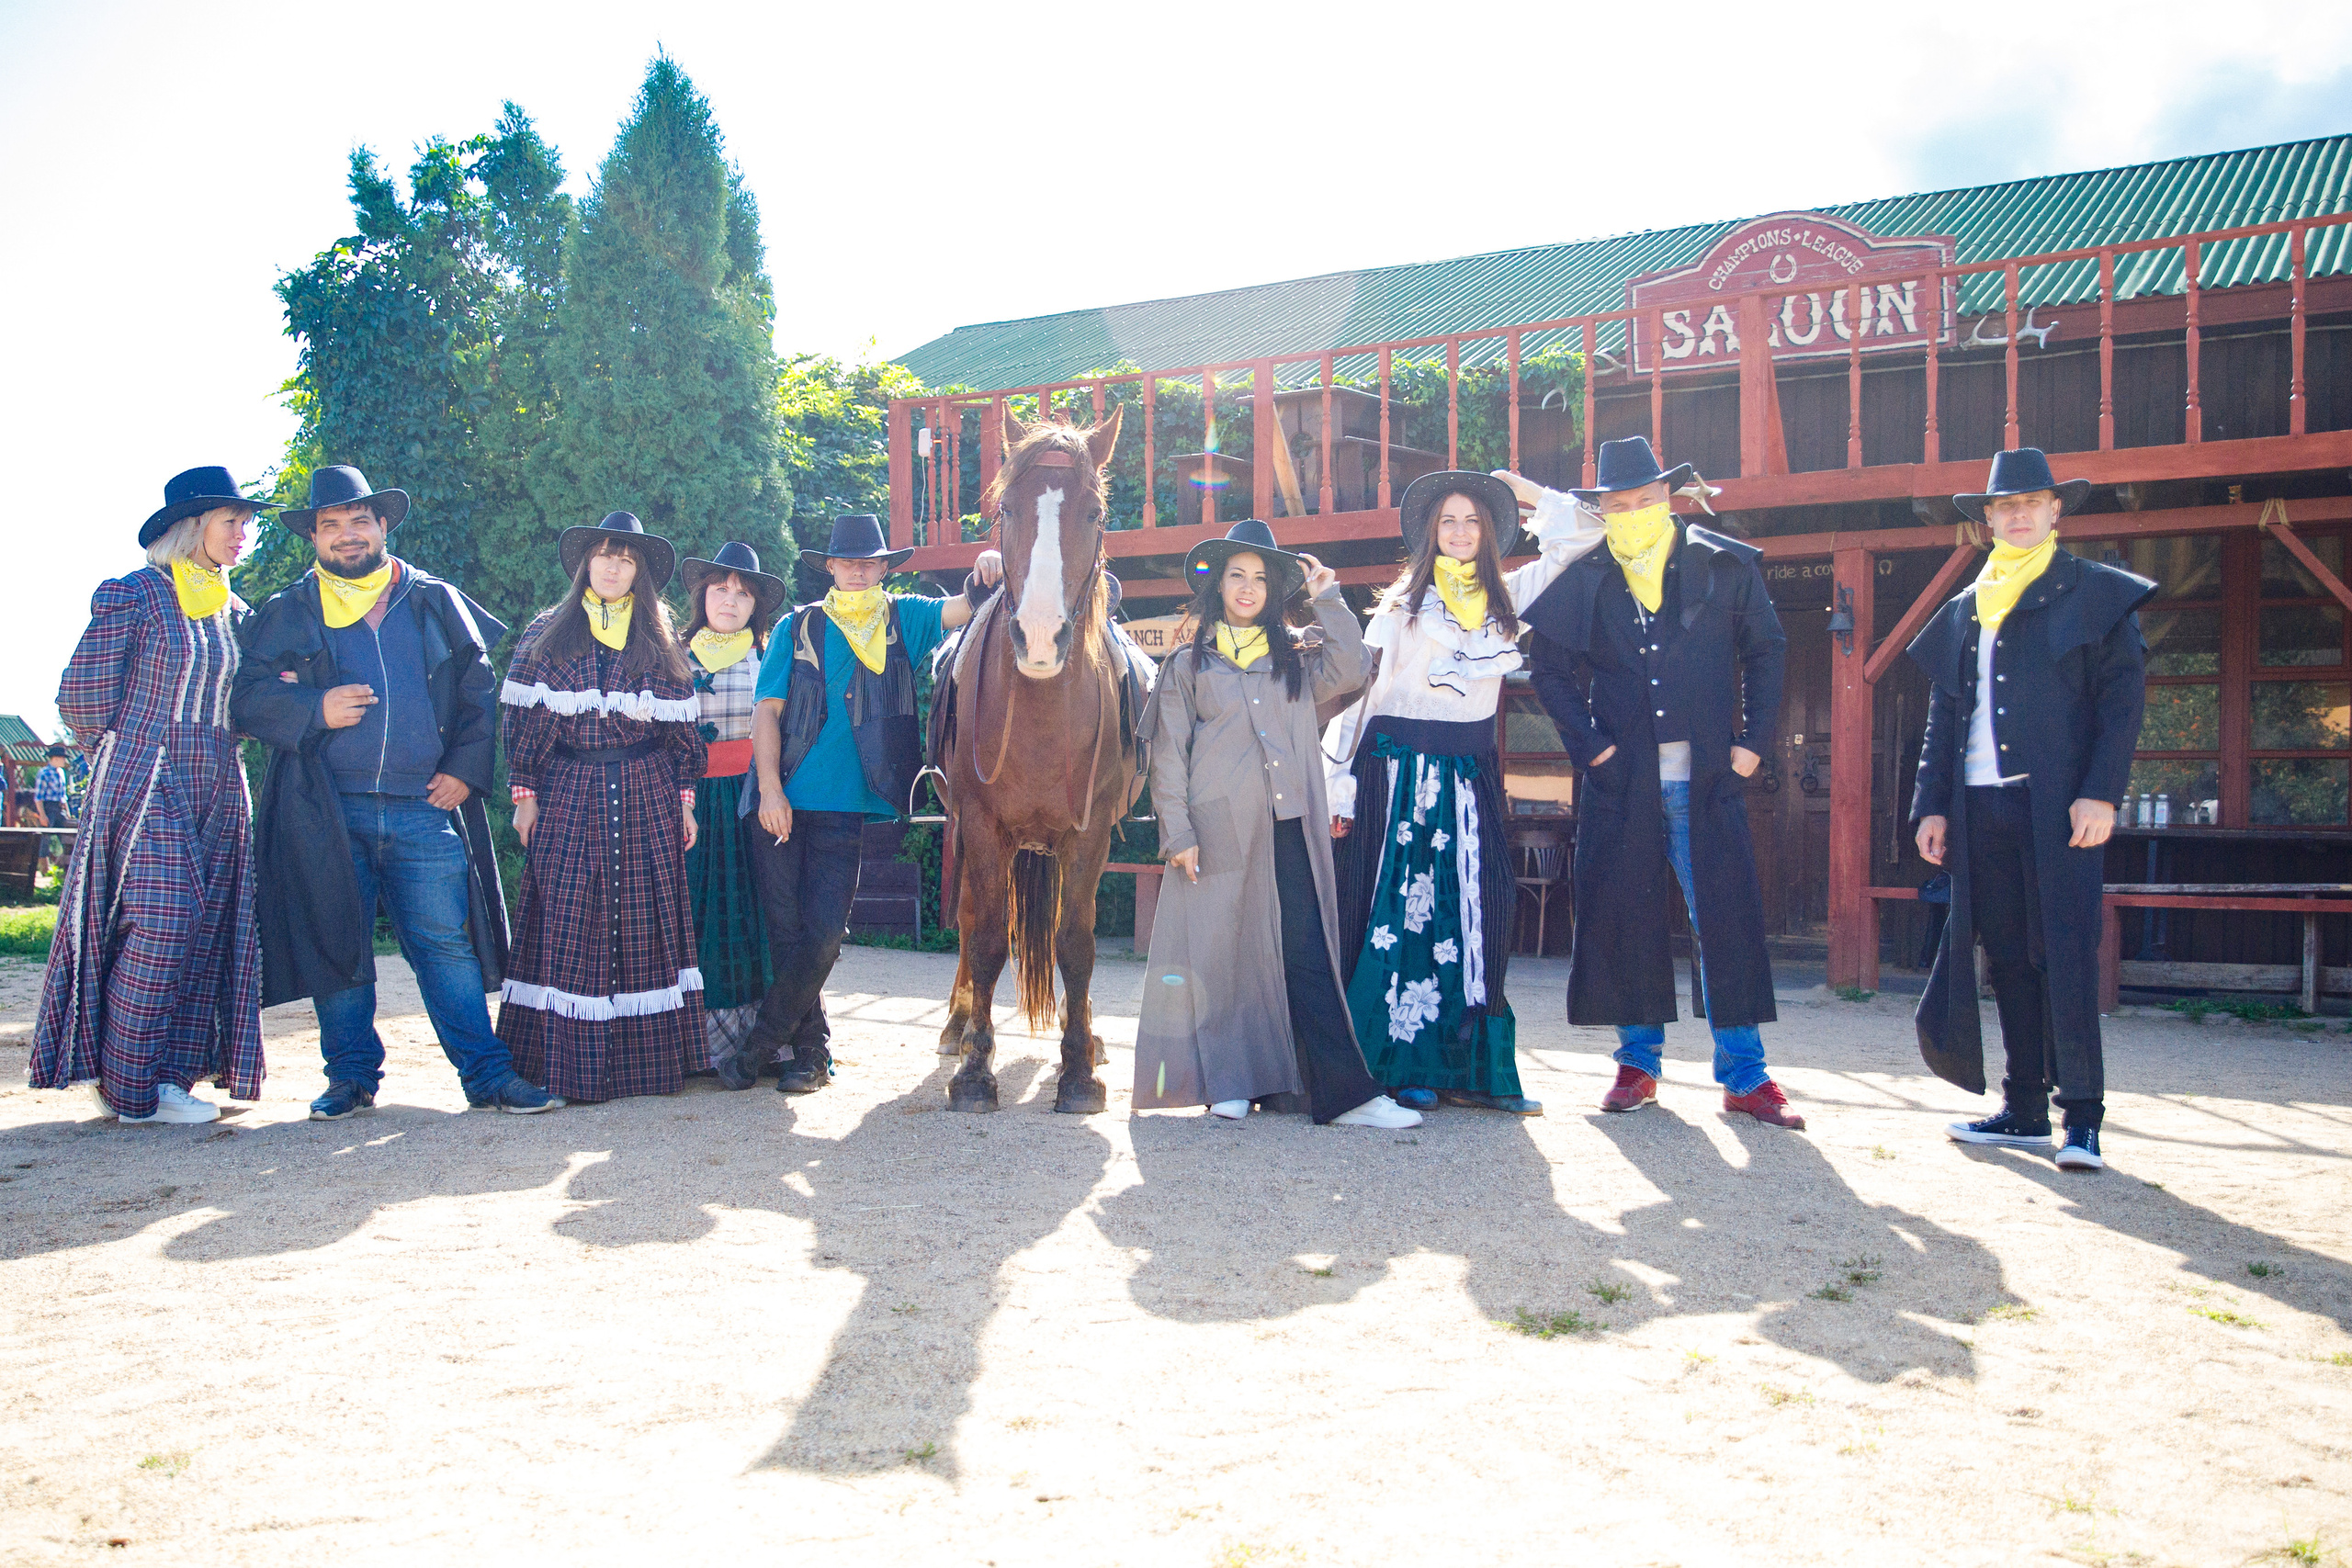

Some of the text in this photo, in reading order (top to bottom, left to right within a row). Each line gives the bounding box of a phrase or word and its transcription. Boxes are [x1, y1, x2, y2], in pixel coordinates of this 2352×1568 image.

[1708, 228, 1864, 291] CHAMPIONS LEAGUE
[1767, 564, 1797, 581] ride
[1802, 566, 1813, 578] a
